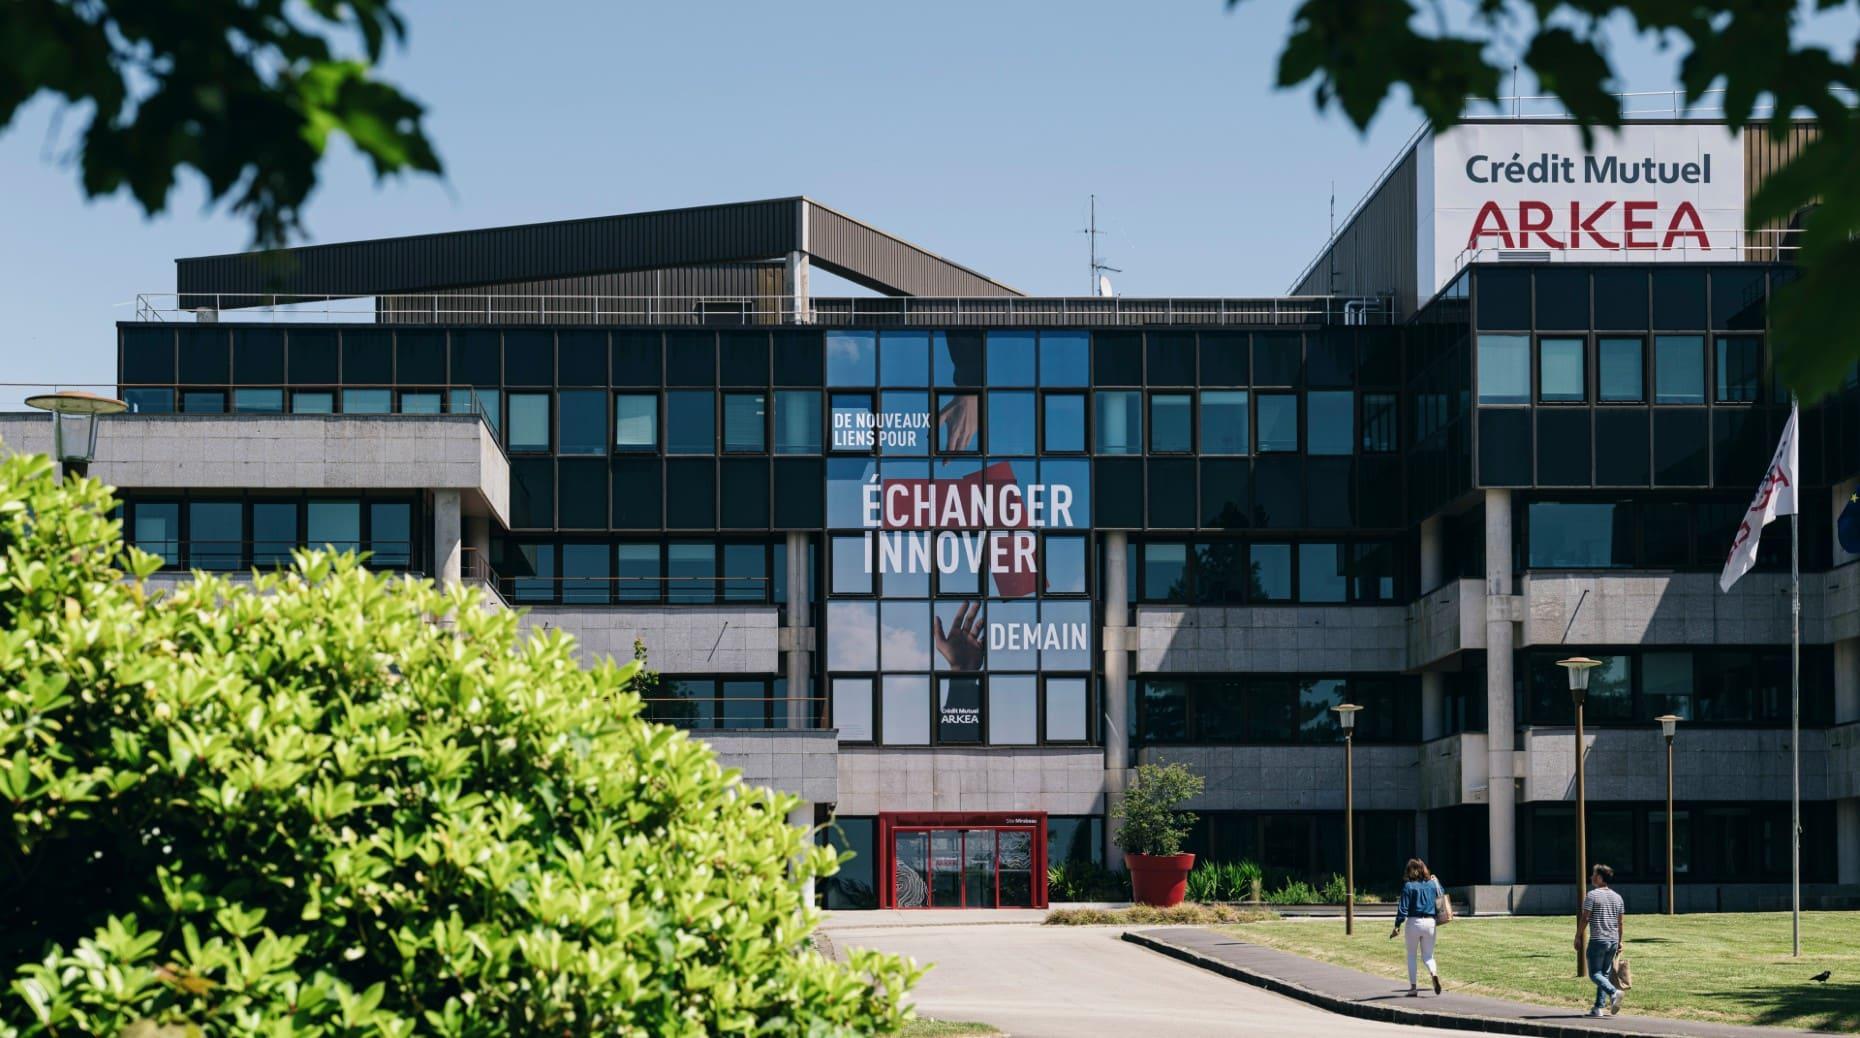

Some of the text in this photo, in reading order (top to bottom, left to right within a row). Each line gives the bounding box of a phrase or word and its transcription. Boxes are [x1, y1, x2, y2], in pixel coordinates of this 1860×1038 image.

[1466, 153, 1711, 183] Crédit Mutuel
[1467, 201, 1711, 250] ARKEA
[834, 413, 931, 429] DE NOUVEAUX
[834, 431, 916, 447] LIENS POUR
[862, 473, 1073, 527] ÉCHANGER
[864, 530, 1037, 574] INNOVER
[990, 623, 1087, 650] DEMAIN
[941, 715, 979, 723] ARKEA
